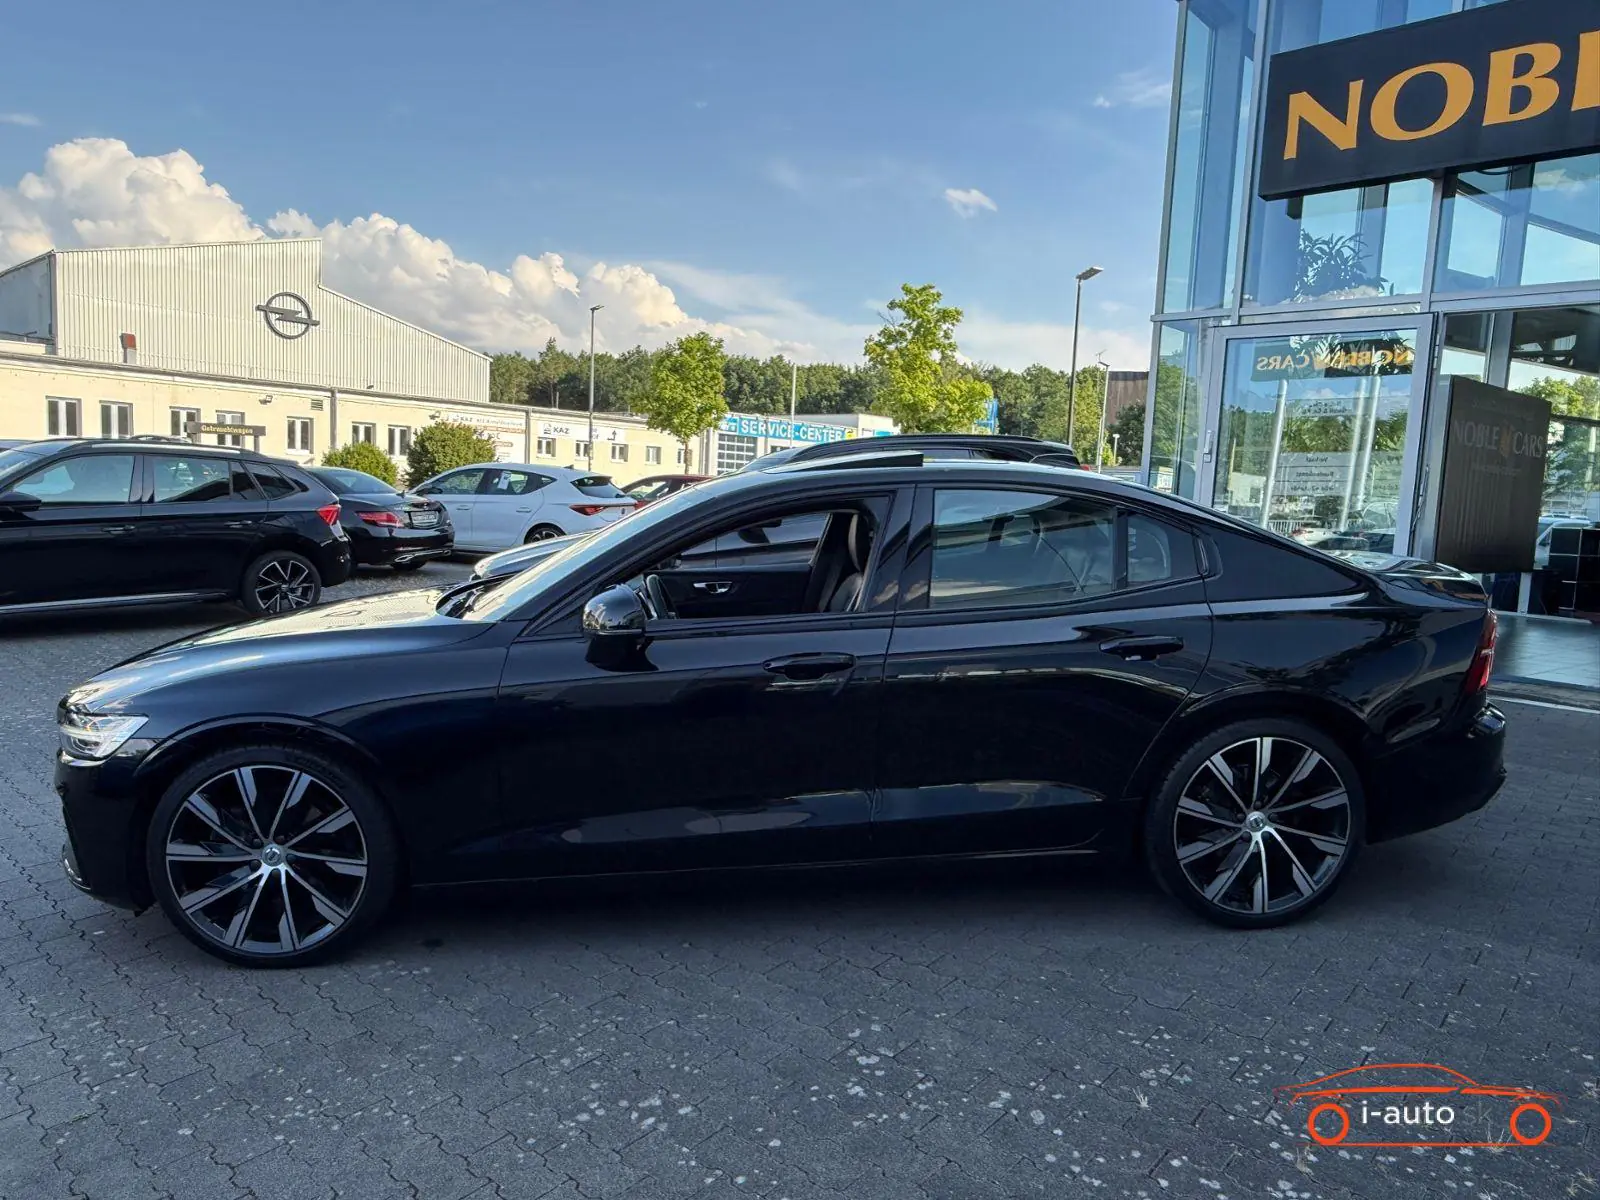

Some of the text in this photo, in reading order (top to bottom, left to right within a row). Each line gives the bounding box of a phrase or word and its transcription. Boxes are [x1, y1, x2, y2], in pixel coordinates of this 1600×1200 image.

[741, 420, 842, 440] SERVICE-CENTER
[1453, 418, 1544, 458] NOBLE CARS
